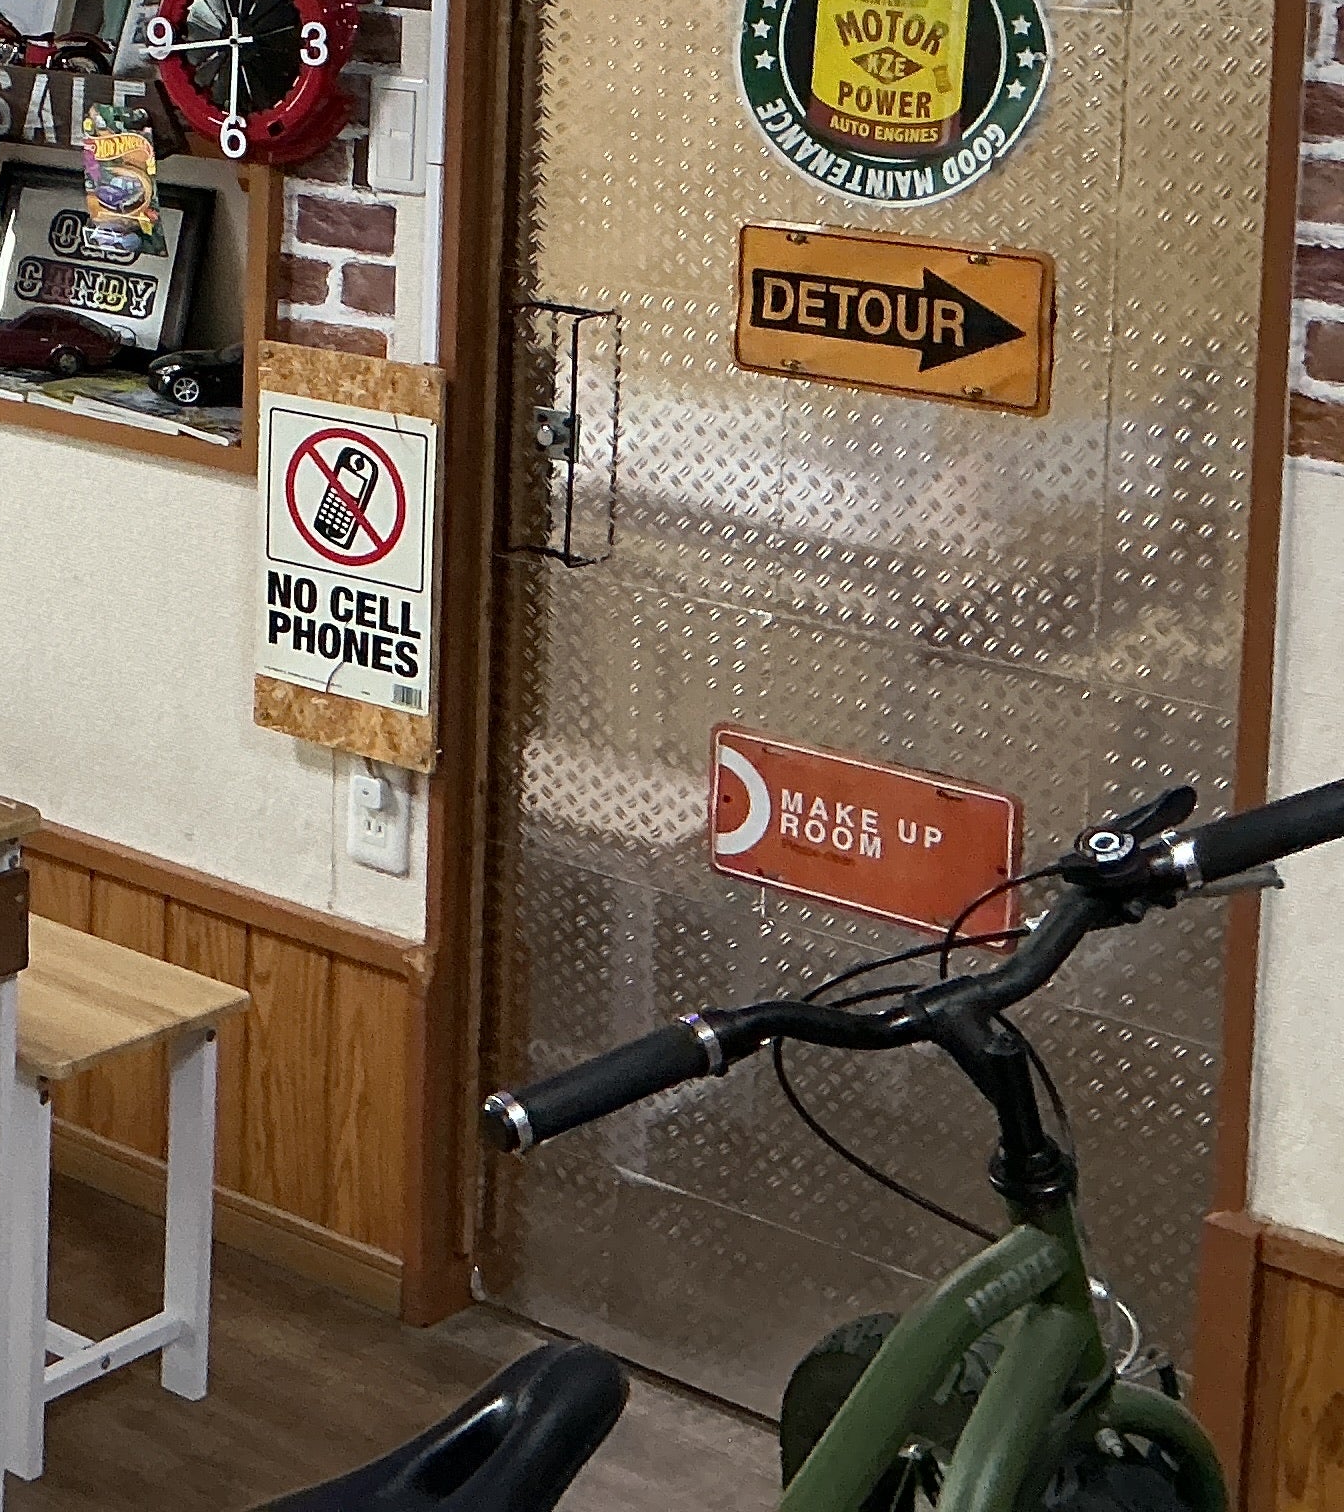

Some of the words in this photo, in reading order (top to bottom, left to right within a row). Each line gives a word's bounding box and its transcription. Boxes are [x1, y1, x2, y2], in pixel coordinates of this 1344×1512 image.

[146, 16, 174, 60] 9
[300, 21, 328, 66] 3
[834, 9, 950, 57] MOTOR
[837, 79, 933, 119] POWER
[220, 115, 247, 159] 6
[756, 97, 936, 199] MAINTENANCE
[830, 114, 869, 139] AUTO
[874, 125, 939, 144] ENGINES
[942, 123, 1007, 187] GOOD
[762, 276, 966, 348] DETOUR
[267, 570, 318, 613] NO
[330, 585, 422, 640] CELL
[267, 609, 420, 679] PHONES
[779, 818, 884, 860] ROOM
[780, 787, 880, 836] MAKE
[896, 817, 945, 850] UP
